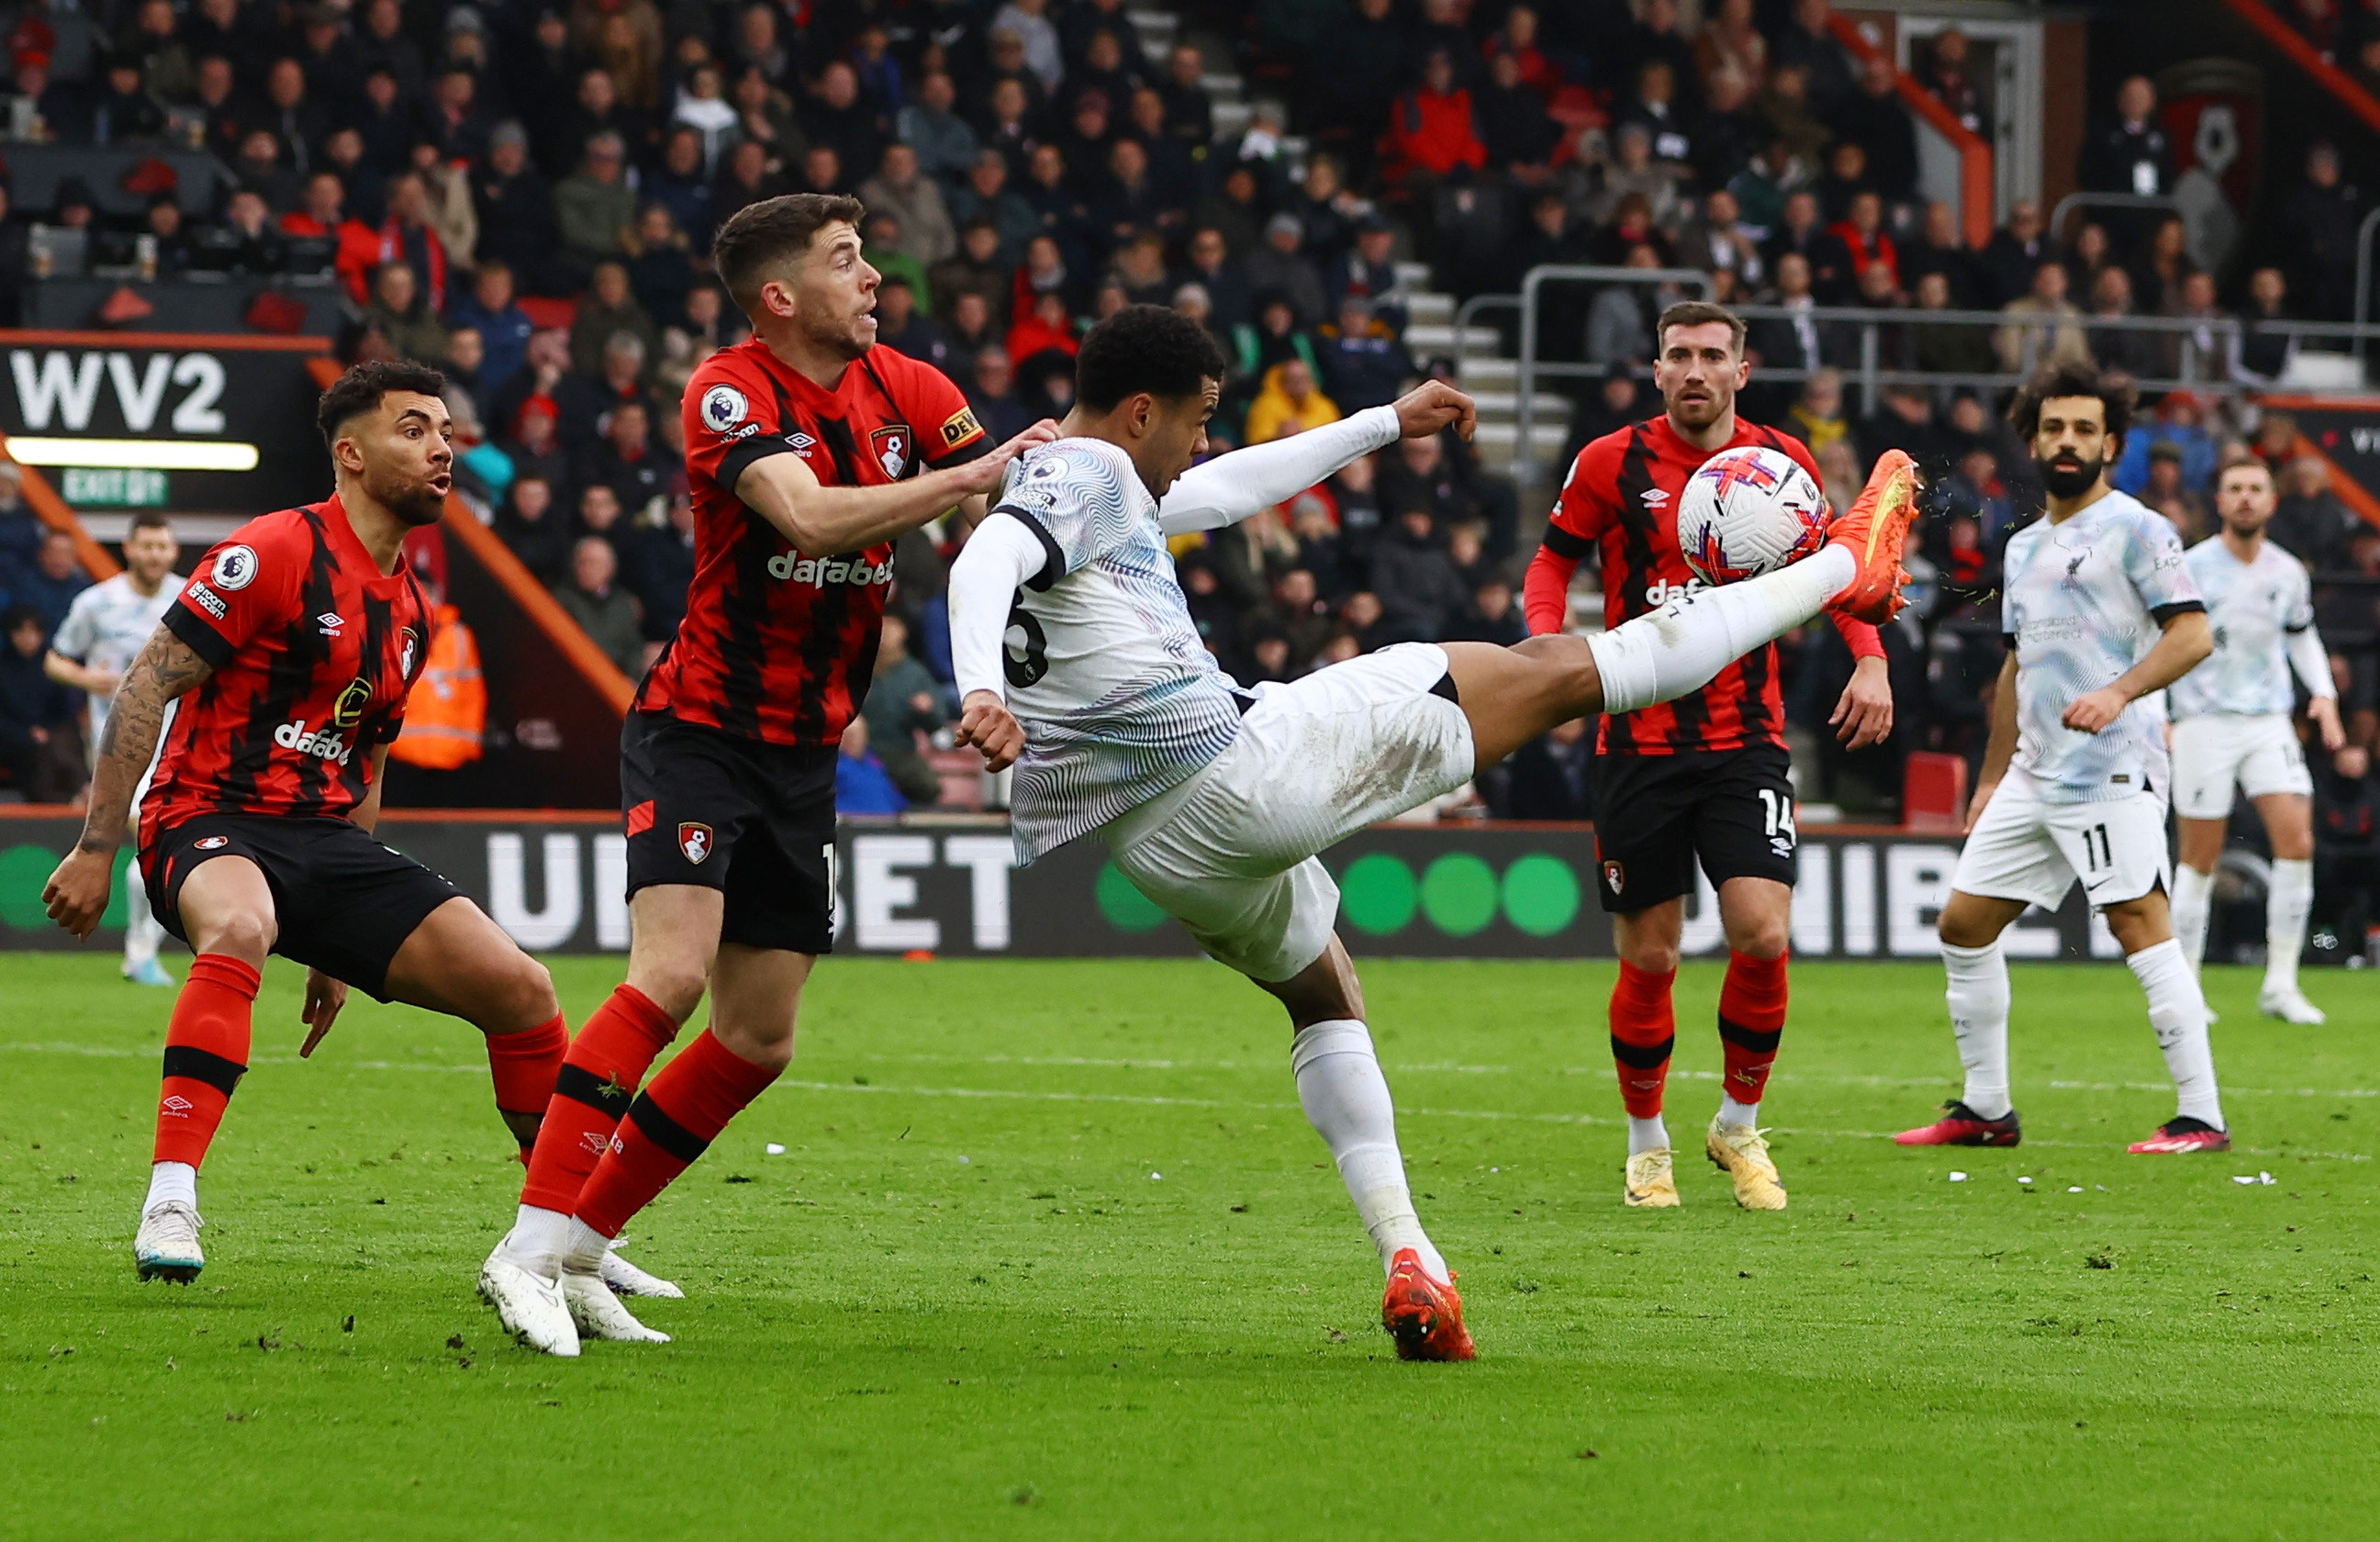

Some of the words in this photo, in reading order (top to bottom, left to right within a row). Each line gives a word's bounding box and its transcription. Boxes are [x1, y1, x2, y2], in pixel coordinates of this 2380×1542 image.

[8, 350, 227, 433] WV2
[767, 550, 894, 590] dafabet
[193, 580, 205, 594] No
[201, 587, 227, 610] room
[196, 594, 225, 620] racism
[318, 627, 341, 637] umbro
[1758, 788, 1796, 846] 14
[2082, 822, 2111, 872] 11
